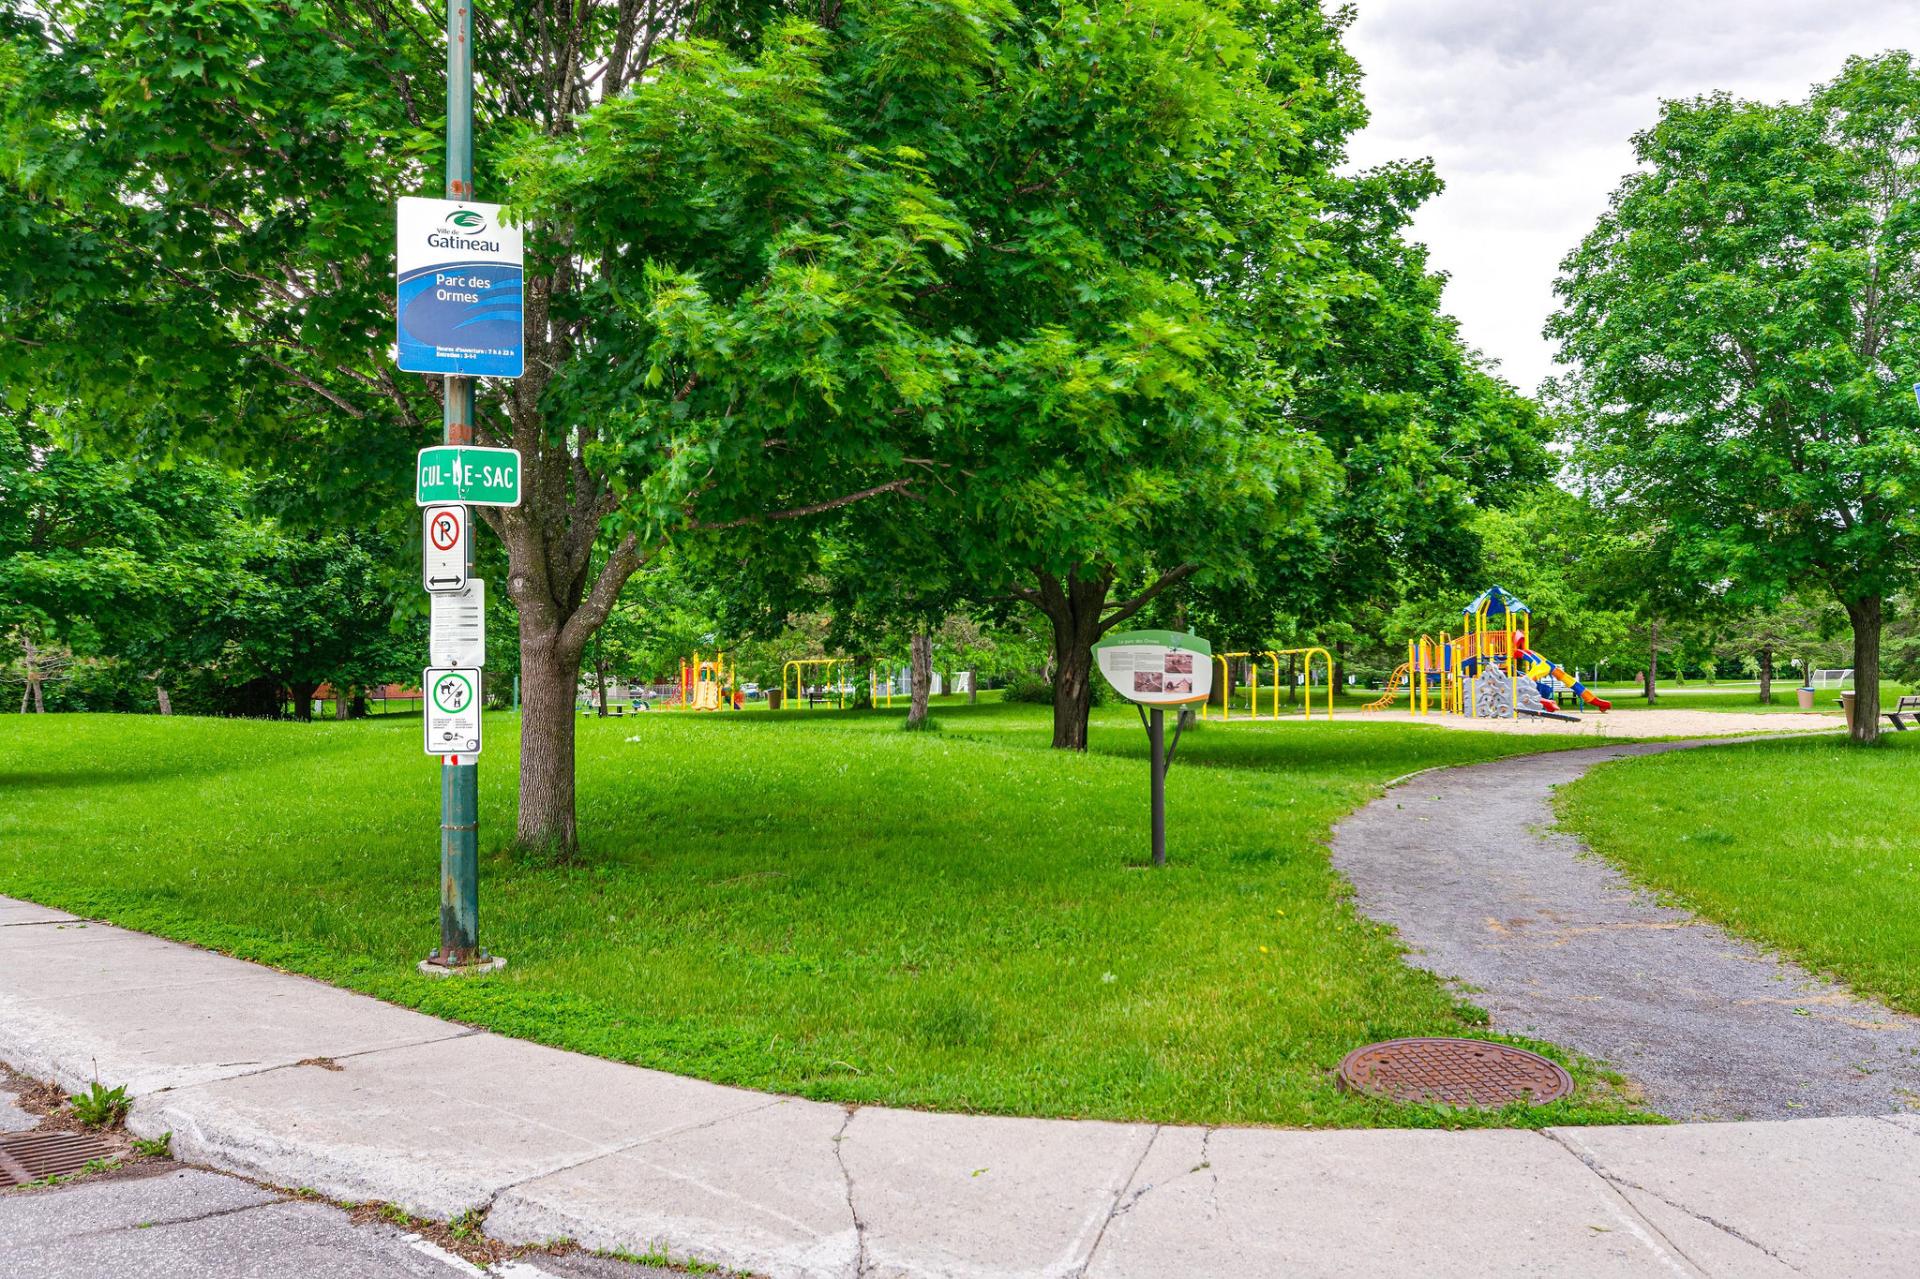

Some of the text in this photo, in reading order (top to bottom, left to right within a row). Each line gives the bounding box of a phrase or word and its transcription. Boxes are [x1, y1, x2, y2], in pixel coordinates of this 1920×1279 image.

[427, 233, 499, 252] Gatineau
[436, 273, 491, 289] Parc des
[436, 289, 479, 303] Ormes
